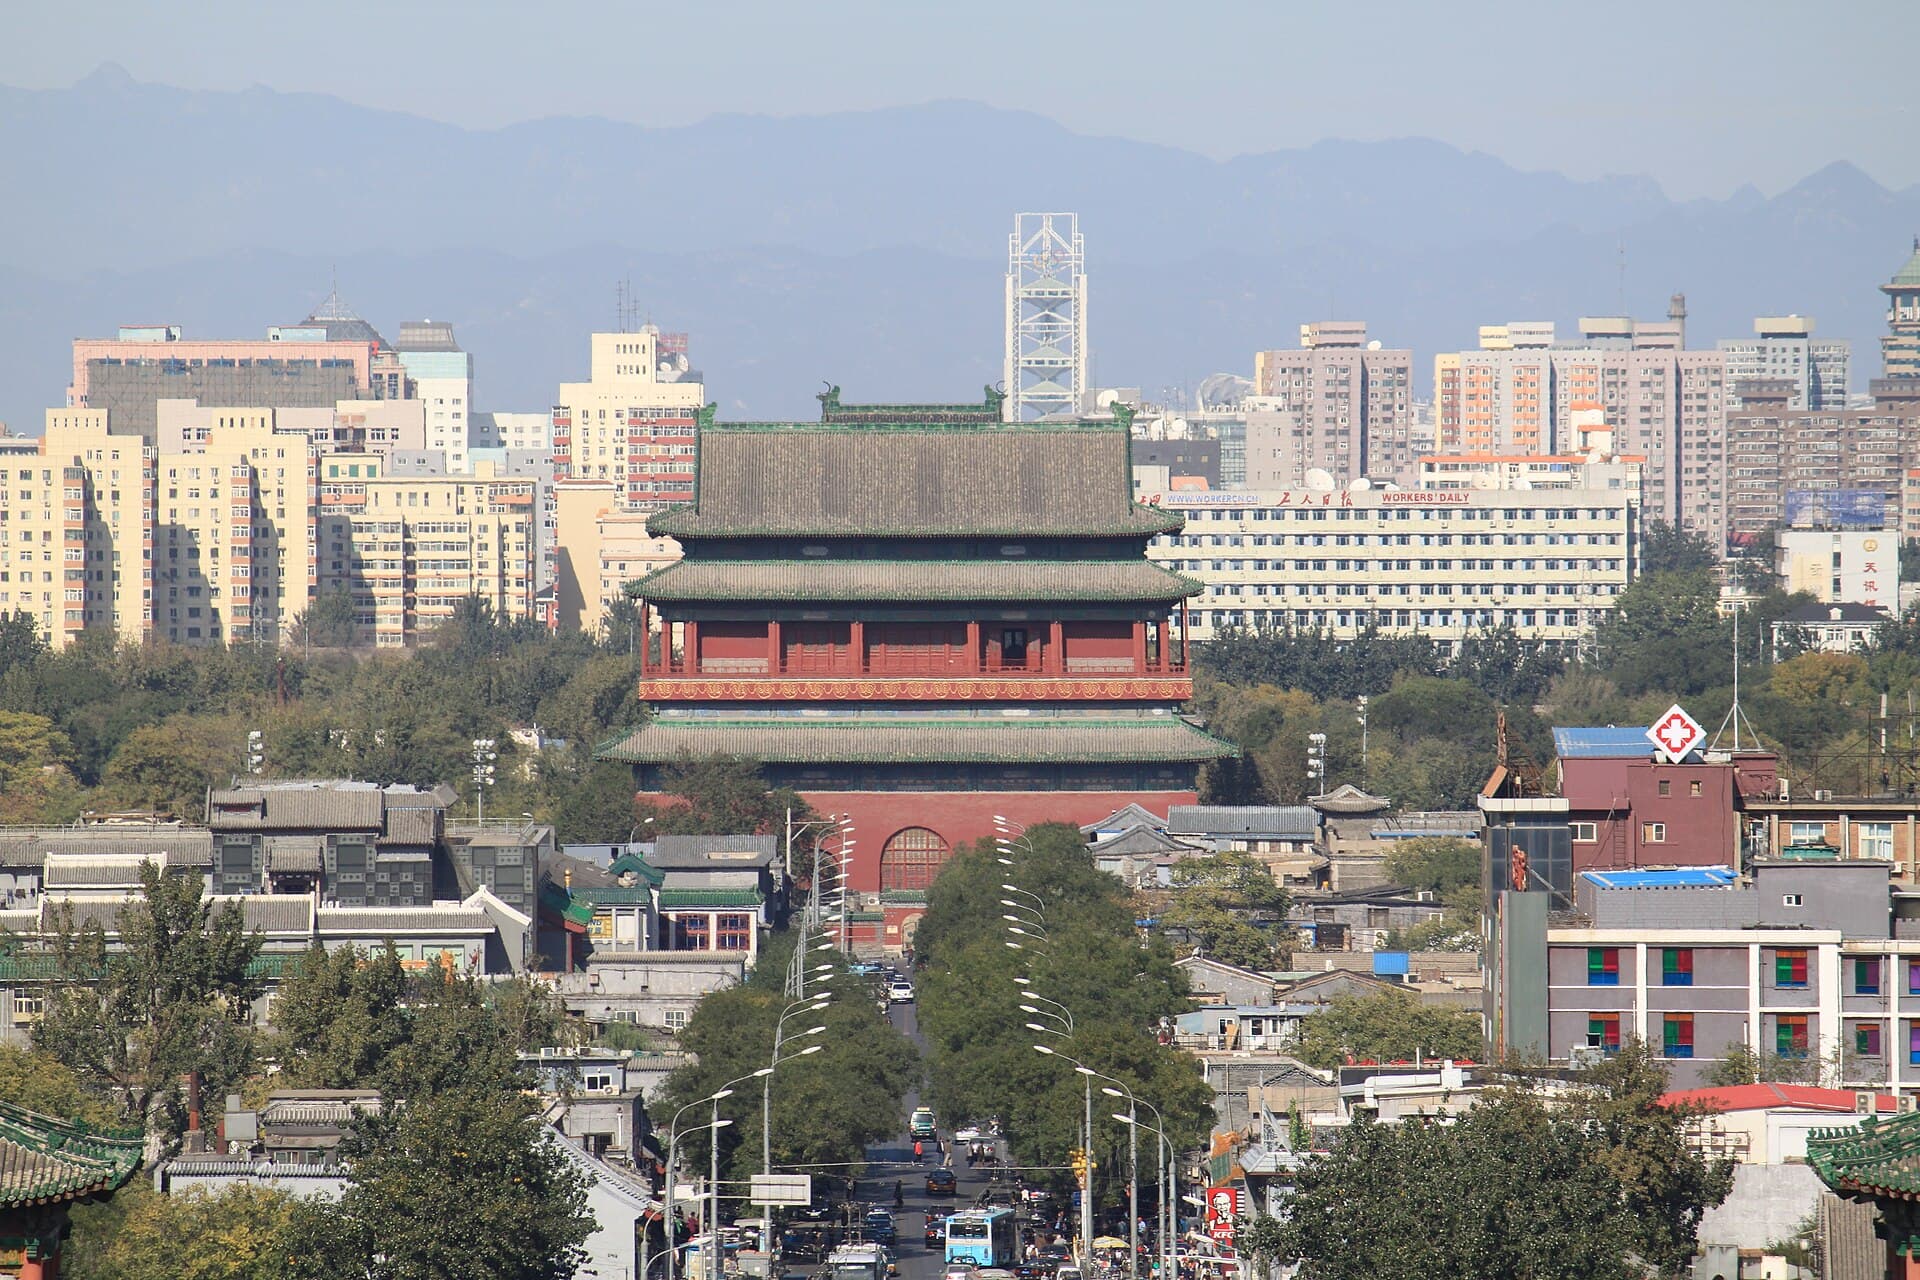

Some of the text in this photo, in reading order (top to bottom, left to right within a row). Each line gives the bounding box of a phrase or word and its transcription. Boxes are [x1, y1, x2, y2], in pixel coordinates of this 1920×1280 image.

[1276, 490, 1353, 507] 工人日报
[1440, 493, 1470, 502] DAILY
